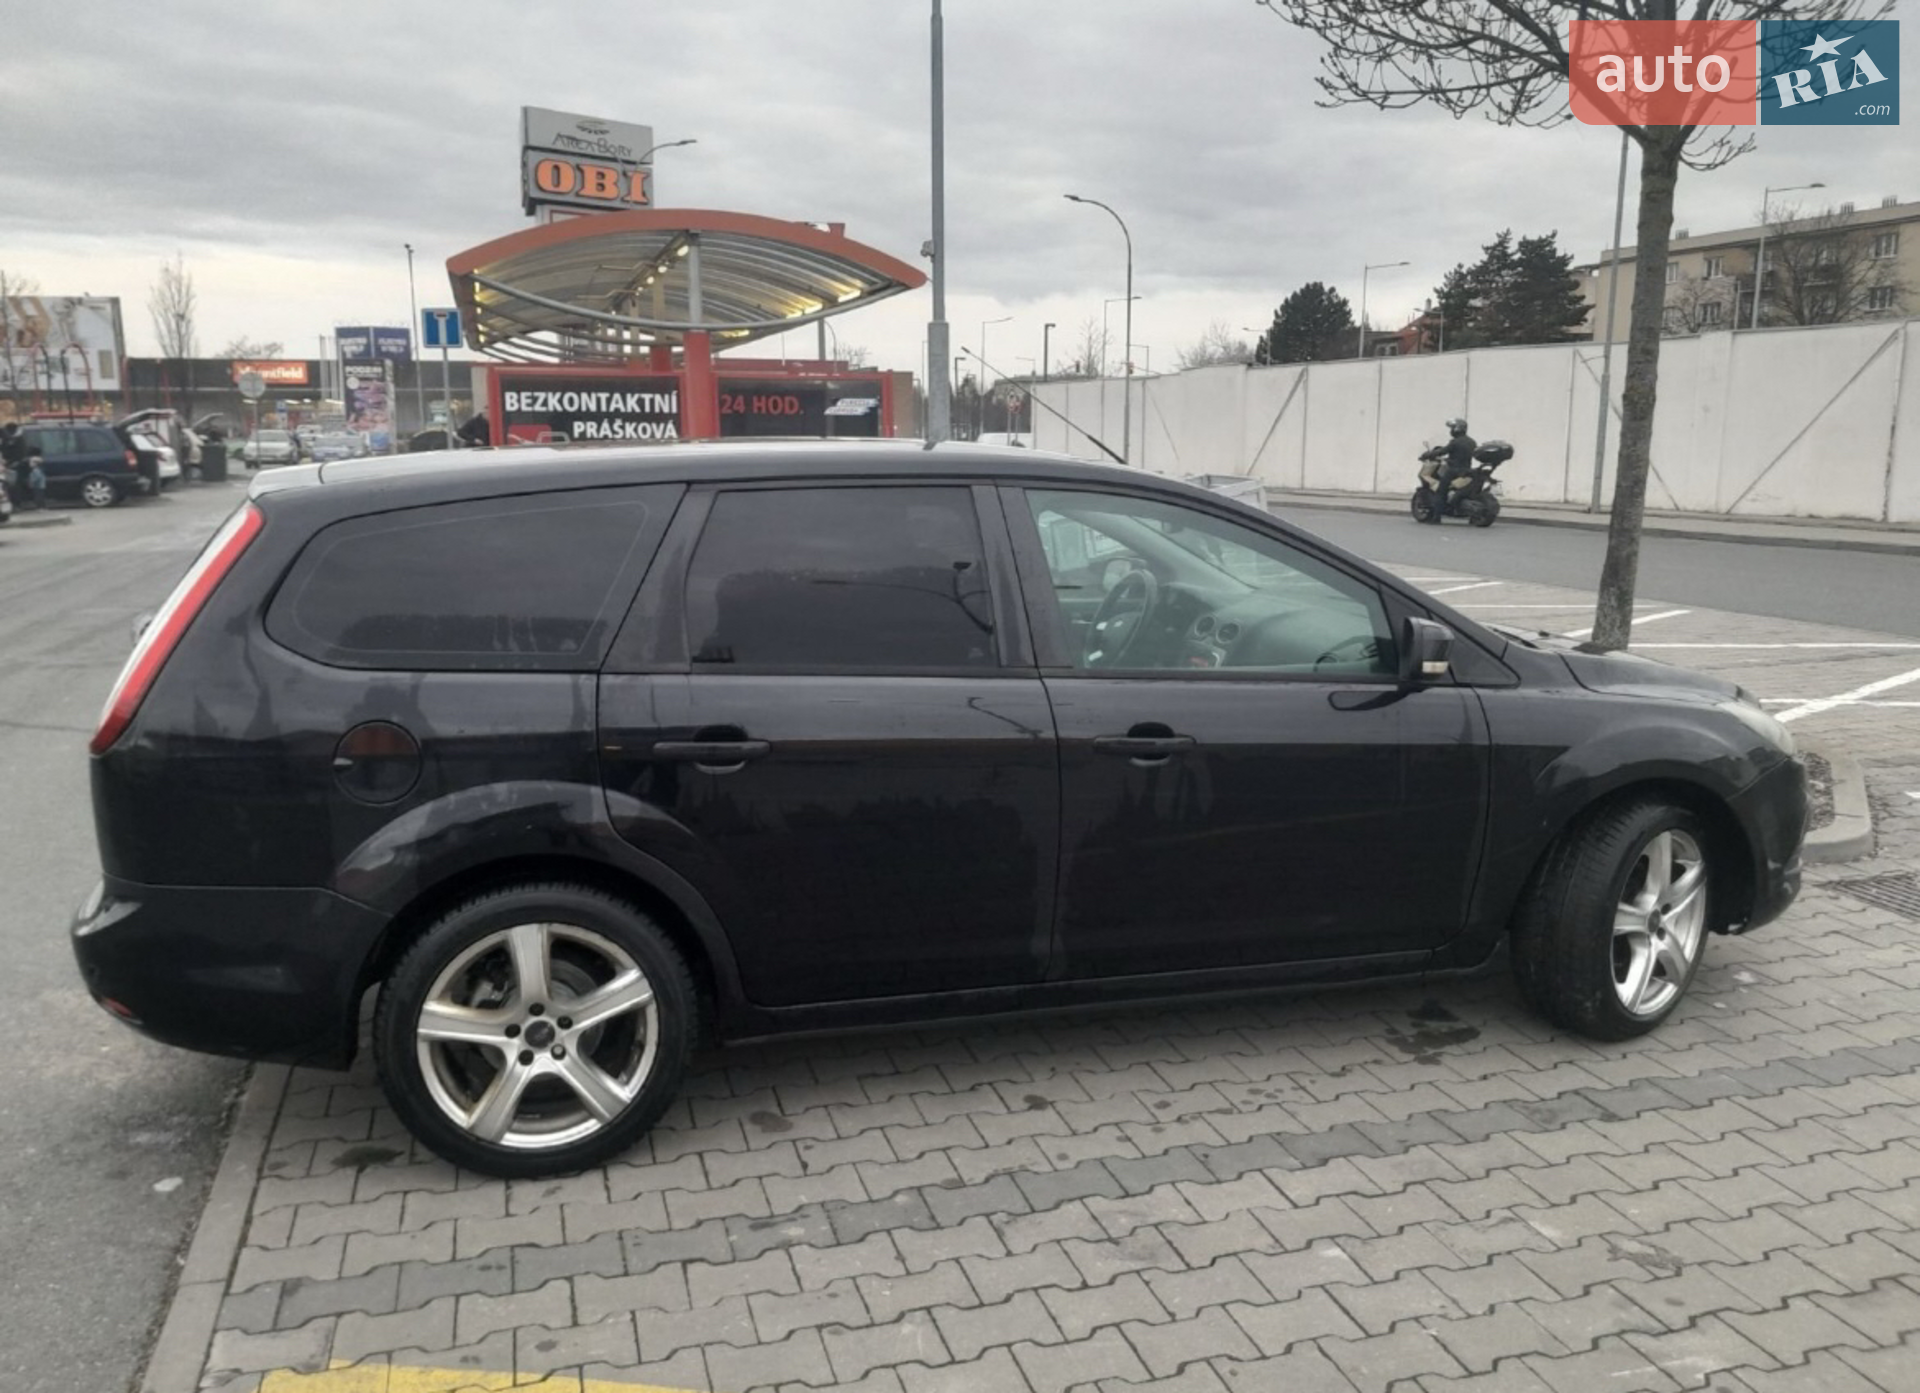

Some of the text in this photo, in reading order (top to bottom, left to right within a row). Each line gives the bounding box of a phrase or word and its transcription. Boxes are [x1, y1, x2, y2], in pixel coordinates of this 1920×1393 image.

[535, 158, 650, 205] OBI
[505, 391, 678, 414] BEZKONTAKTNÍ
[720, 393, 804, 415] 24 HOD.
[573, 418, 678, 439] PRÁŠKOVÁ
